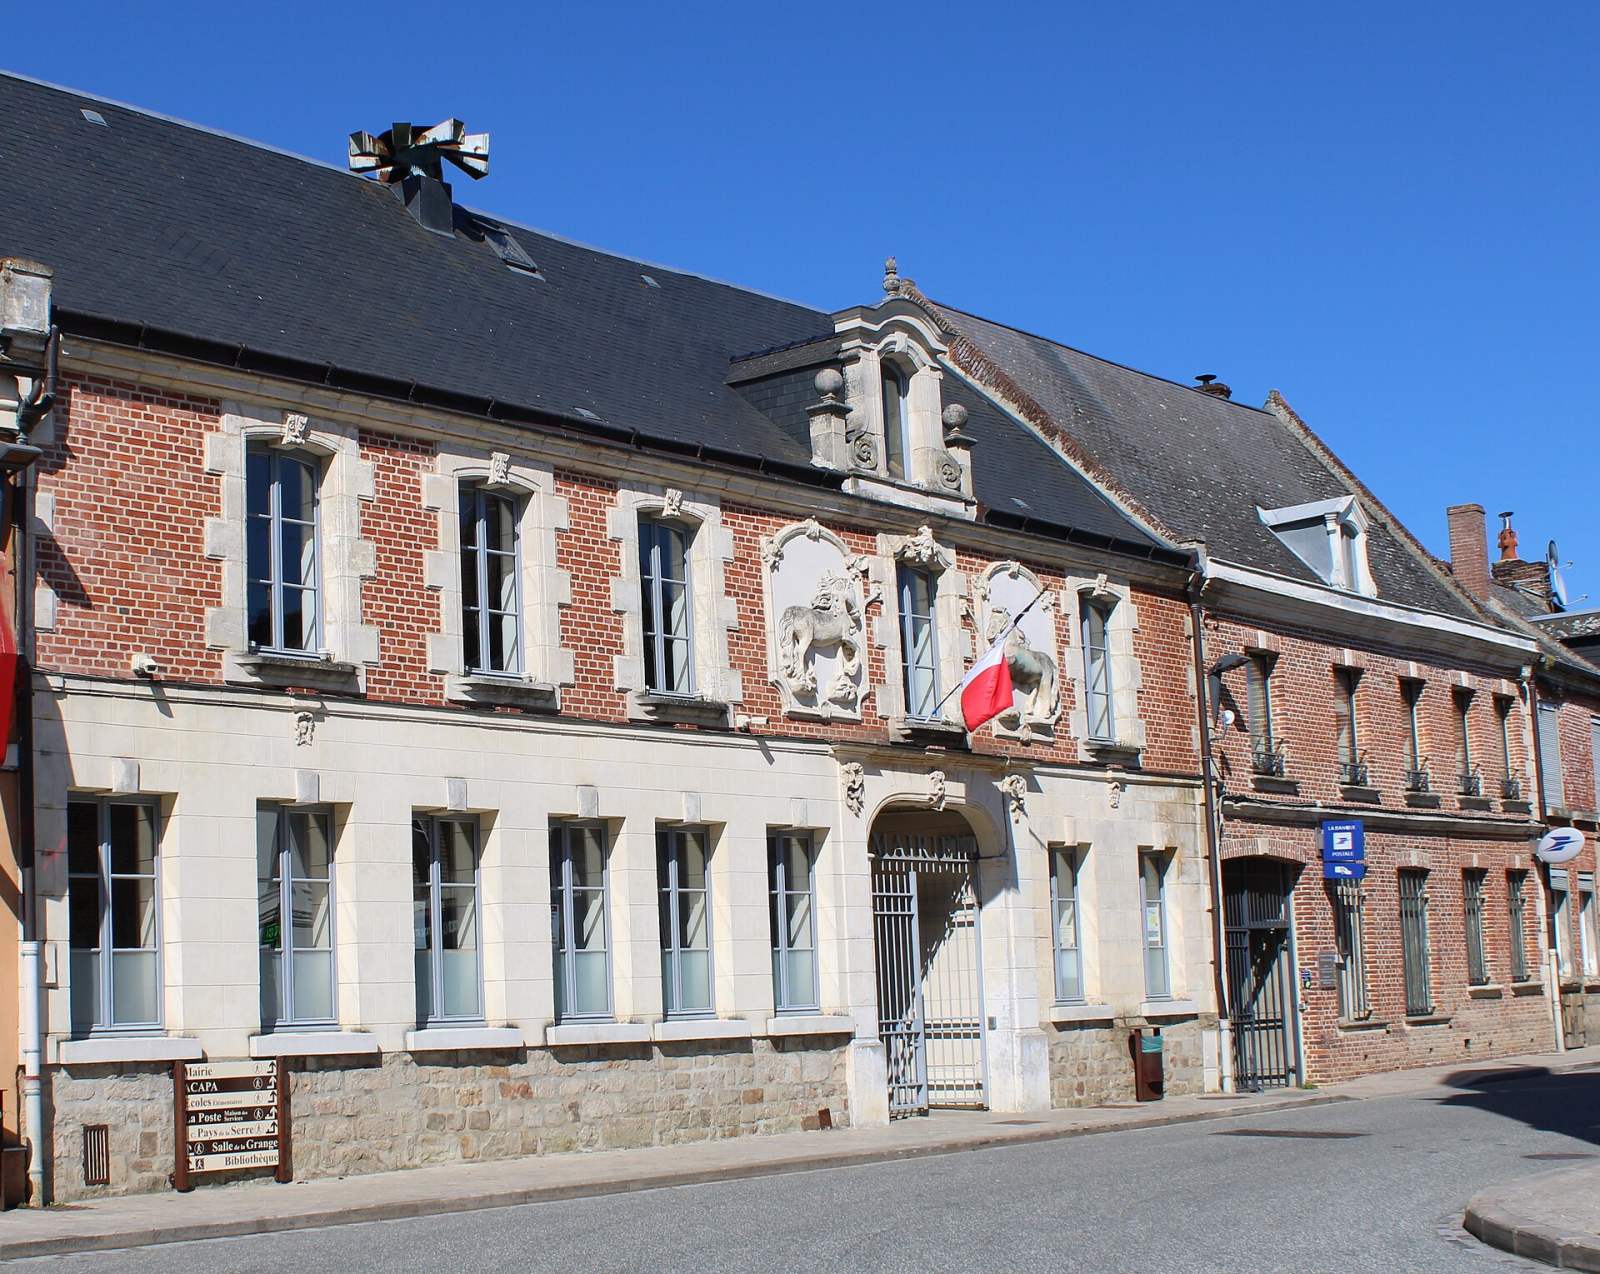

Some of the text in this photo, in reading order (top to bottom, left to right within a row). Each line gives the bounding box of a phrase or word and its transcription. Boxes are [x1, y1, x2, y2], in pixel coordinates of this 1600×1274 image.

[187, 1097, 212, 1107] coles
[188, 1112, 222, 1123] a Poste
[197, 1127, 218, 1139] Pays
[231, 1125, 254, 1136] Serre
[212, 1141, 234, 1152] Salle
[246, 1139, 278, 1151] Grange
[224, 1154, 279, 1166] Bibliothèque
